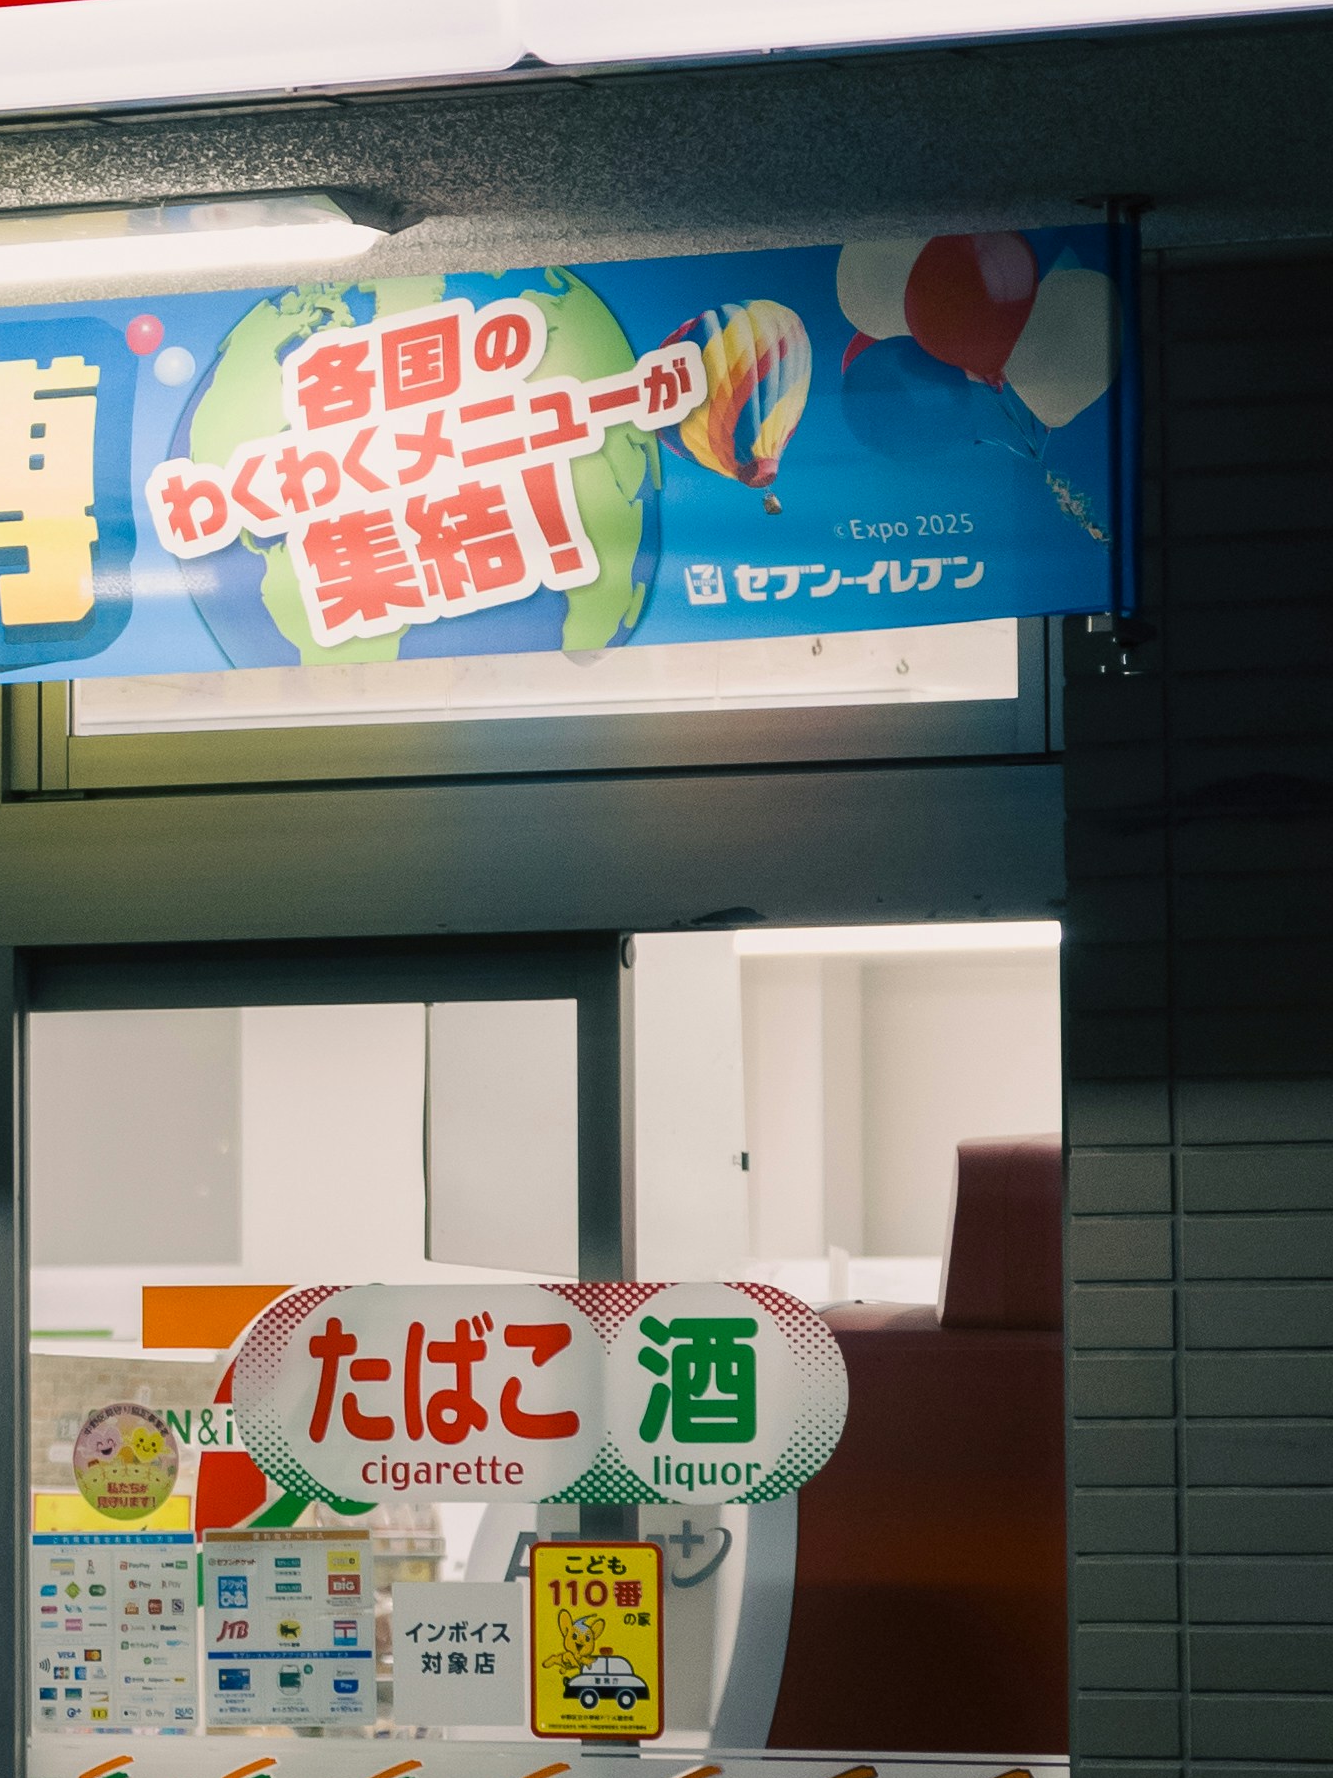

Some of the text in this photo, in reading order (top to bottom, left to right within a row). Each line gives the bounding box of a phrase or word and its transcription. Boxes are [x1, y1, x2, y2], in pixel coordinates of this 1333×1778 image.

[295, 312, 532, 431] 各国の
[161, 358, 693, 544] わくわくメニューが
[915, 512, 974, 537] 2025
[303, 466, 584, 629] 集結！
[307, 1311, 581, 1446] たばこ
[637, 1315, 759, 1445] 酒
[362, 1453, 525, 1492] cigarette
[652, 1453, 763, 1493] liquor
[564, 1554, 628, 1576] こども
[547, 1579, 643, 1608] 110番
[216, 1620, 250, 1642] JTB
[405, 1620, 511, 1644] インボイス
[623, 1612, 652, 1628] の家
[57, 1651, 76, 1659] VISA
[421, 1651, 496, 1675] 対象店
